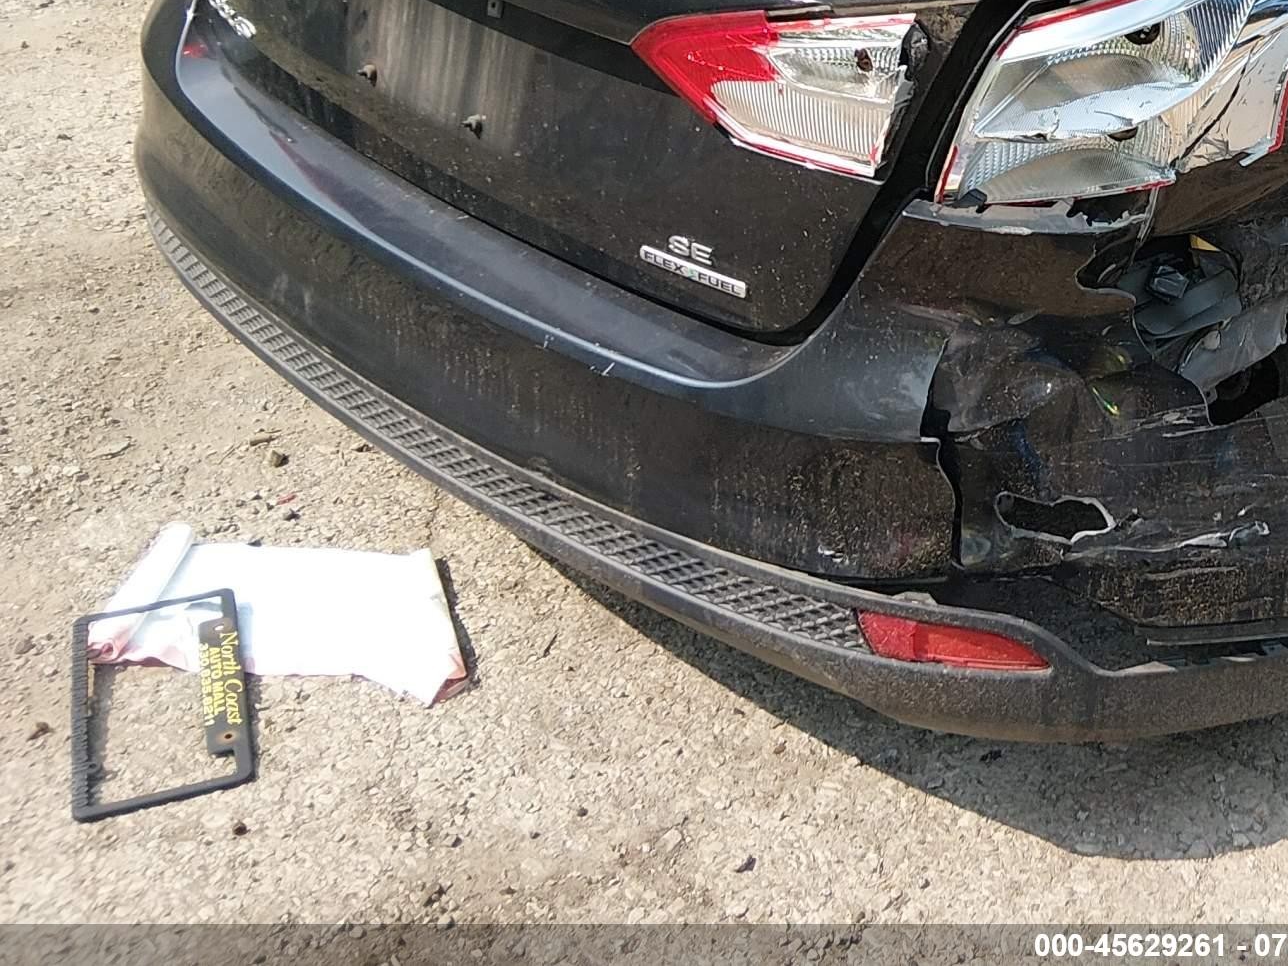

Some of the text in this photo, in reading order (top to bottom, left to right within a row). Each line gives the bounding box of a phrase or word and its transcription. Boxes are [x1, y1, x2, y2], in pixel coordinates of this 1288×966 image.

[643, 249, 743, 296] FLEX FUEL
[667, 235, 714, 266] SE
[209, 647, 226, 716] AUTO MALL
[219, 631, 243, 726] North Coast
